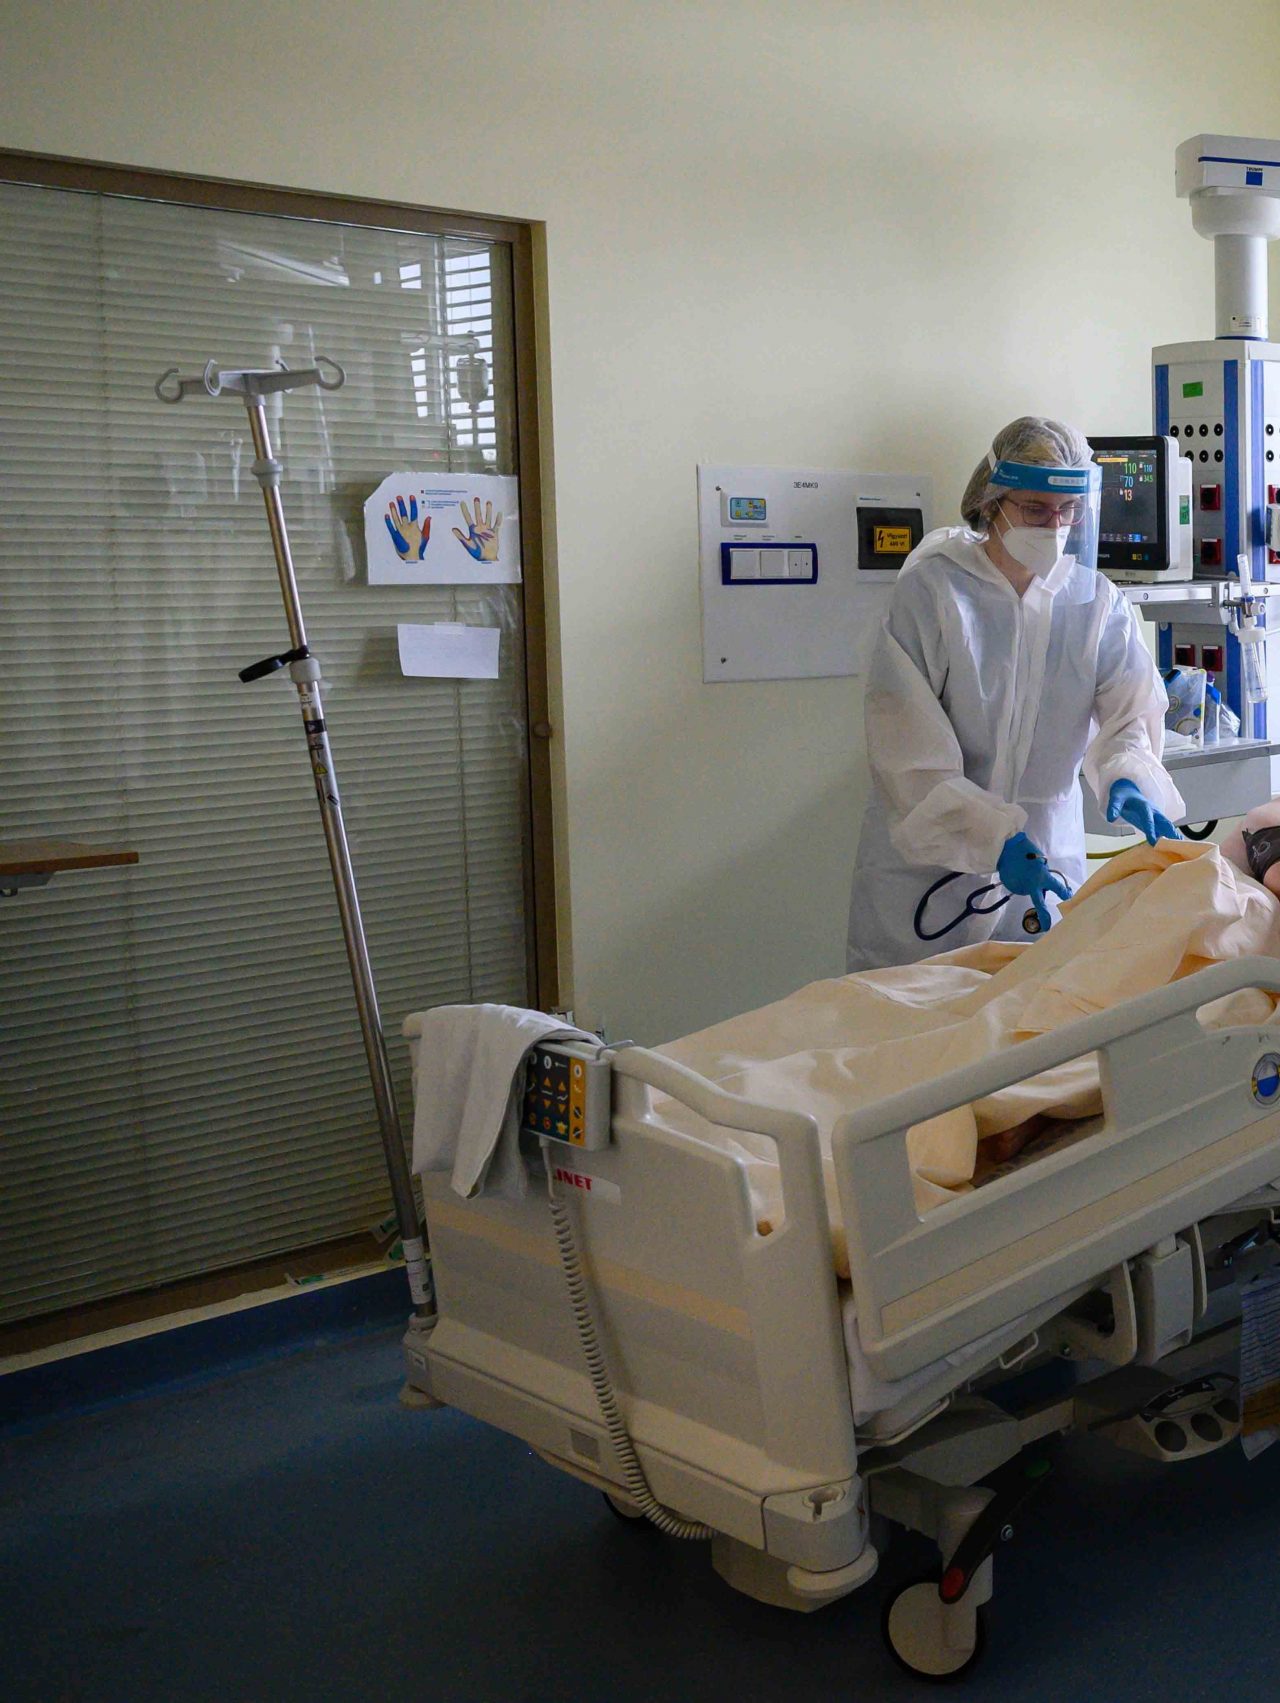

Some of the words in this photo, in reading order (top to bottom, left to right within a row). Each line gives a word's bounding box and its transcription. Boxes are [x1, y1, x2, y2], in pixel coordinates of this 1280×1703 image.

[1124, 462, 1137, 474] 110
[1124, 475, 1134, 488] 70
[1124, 489, 1132, 501] 13
[552, 1168, 592, 1191] INET
